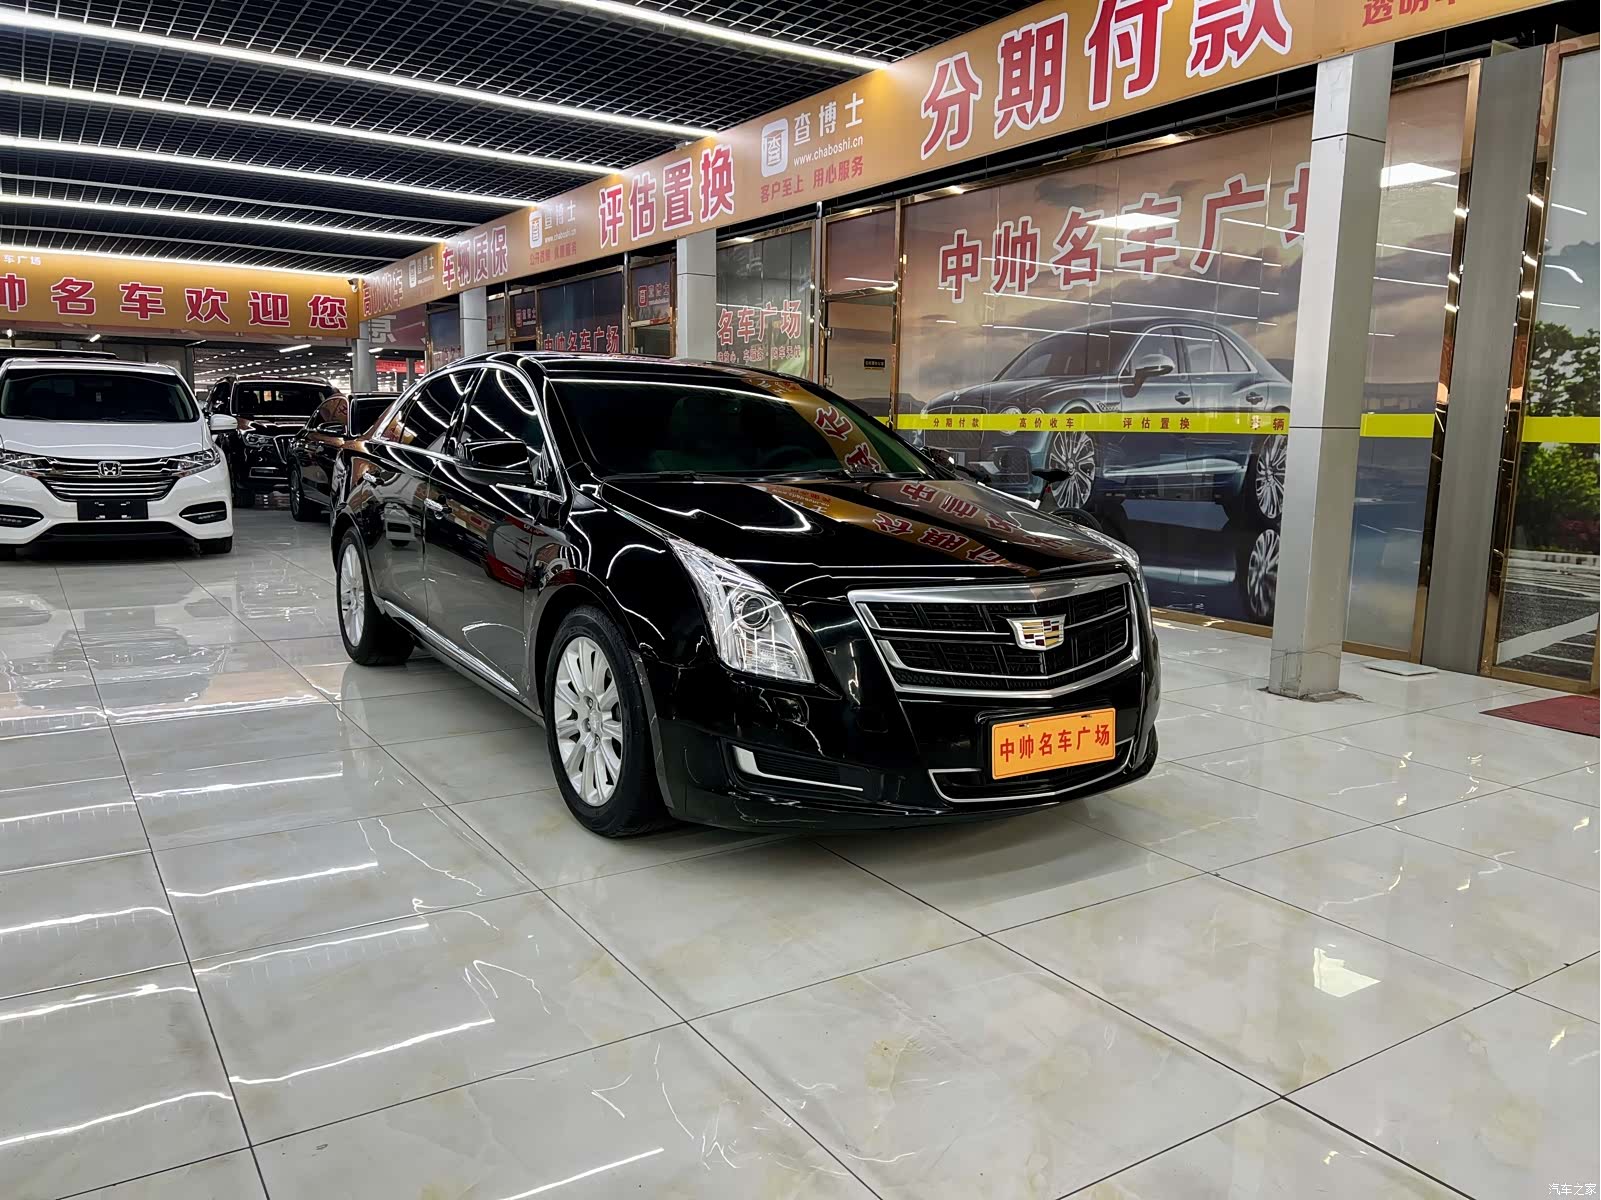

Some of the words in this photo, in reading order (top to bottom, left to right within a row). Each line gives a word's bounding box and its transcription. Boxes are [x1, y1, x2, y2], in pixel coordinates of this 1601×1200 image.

[921, 0, 1292, 160] 分期付款
[794, 92, 864, 146] 查博士
[794, 135, 864, 167] www.chaboshi.cn
[599, 144, 735, 248] 评估置换
[760, 175, 804, 203] 客户至上
[813, 156, 864, 189] 用心服务
[442, 225, 508, 290] 车辆质保
[933, 418, 980, 428] 分期付款
[1019, 417, 1075, 429] 高价收车
[1122, 416, 1191, 430] 评估置换
[1000, 724, 1110, 763] 中帅名车广场
